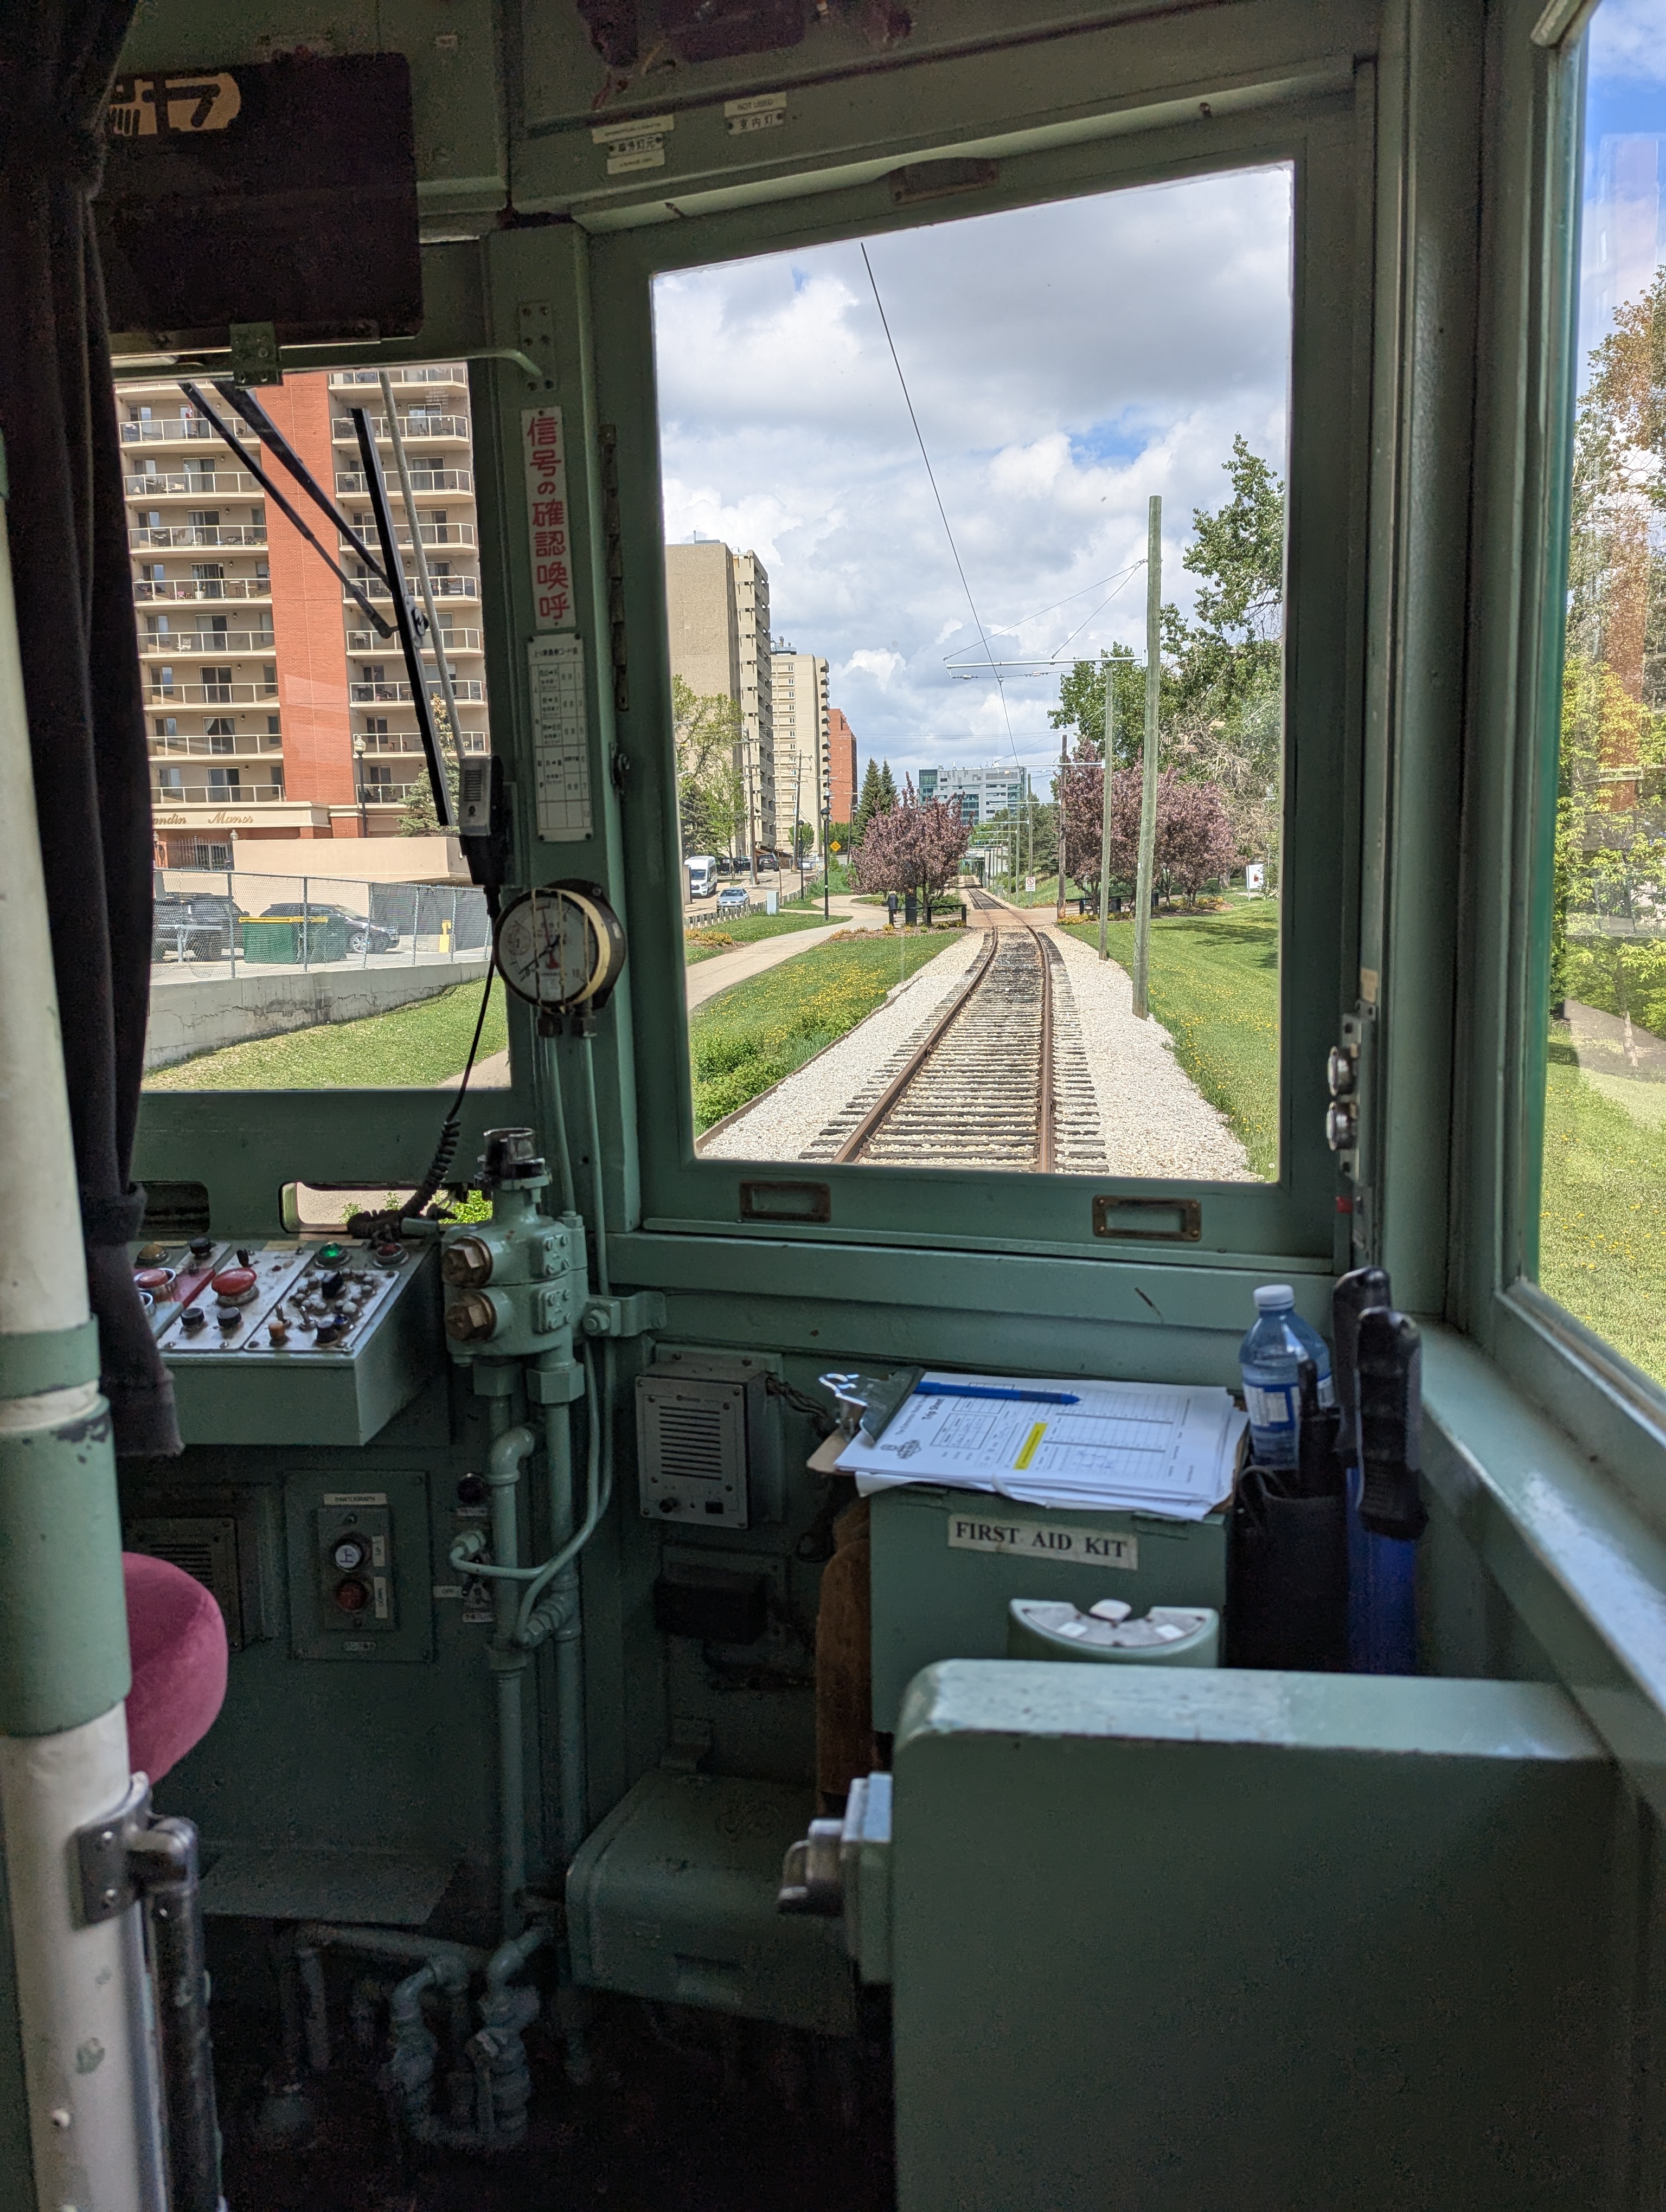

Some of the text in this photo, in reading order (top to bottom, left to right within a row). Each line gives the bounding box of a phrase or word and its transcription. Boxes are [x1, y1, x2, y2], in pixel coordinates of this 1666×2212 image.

[527, 416, 570, 620] 信号の確認喚呼
[208, 810, 254, 824] Manor
[921, 1411, 938, 1420] Trip
[956, 1521, 1127, 1558] FIRST AID KIT
